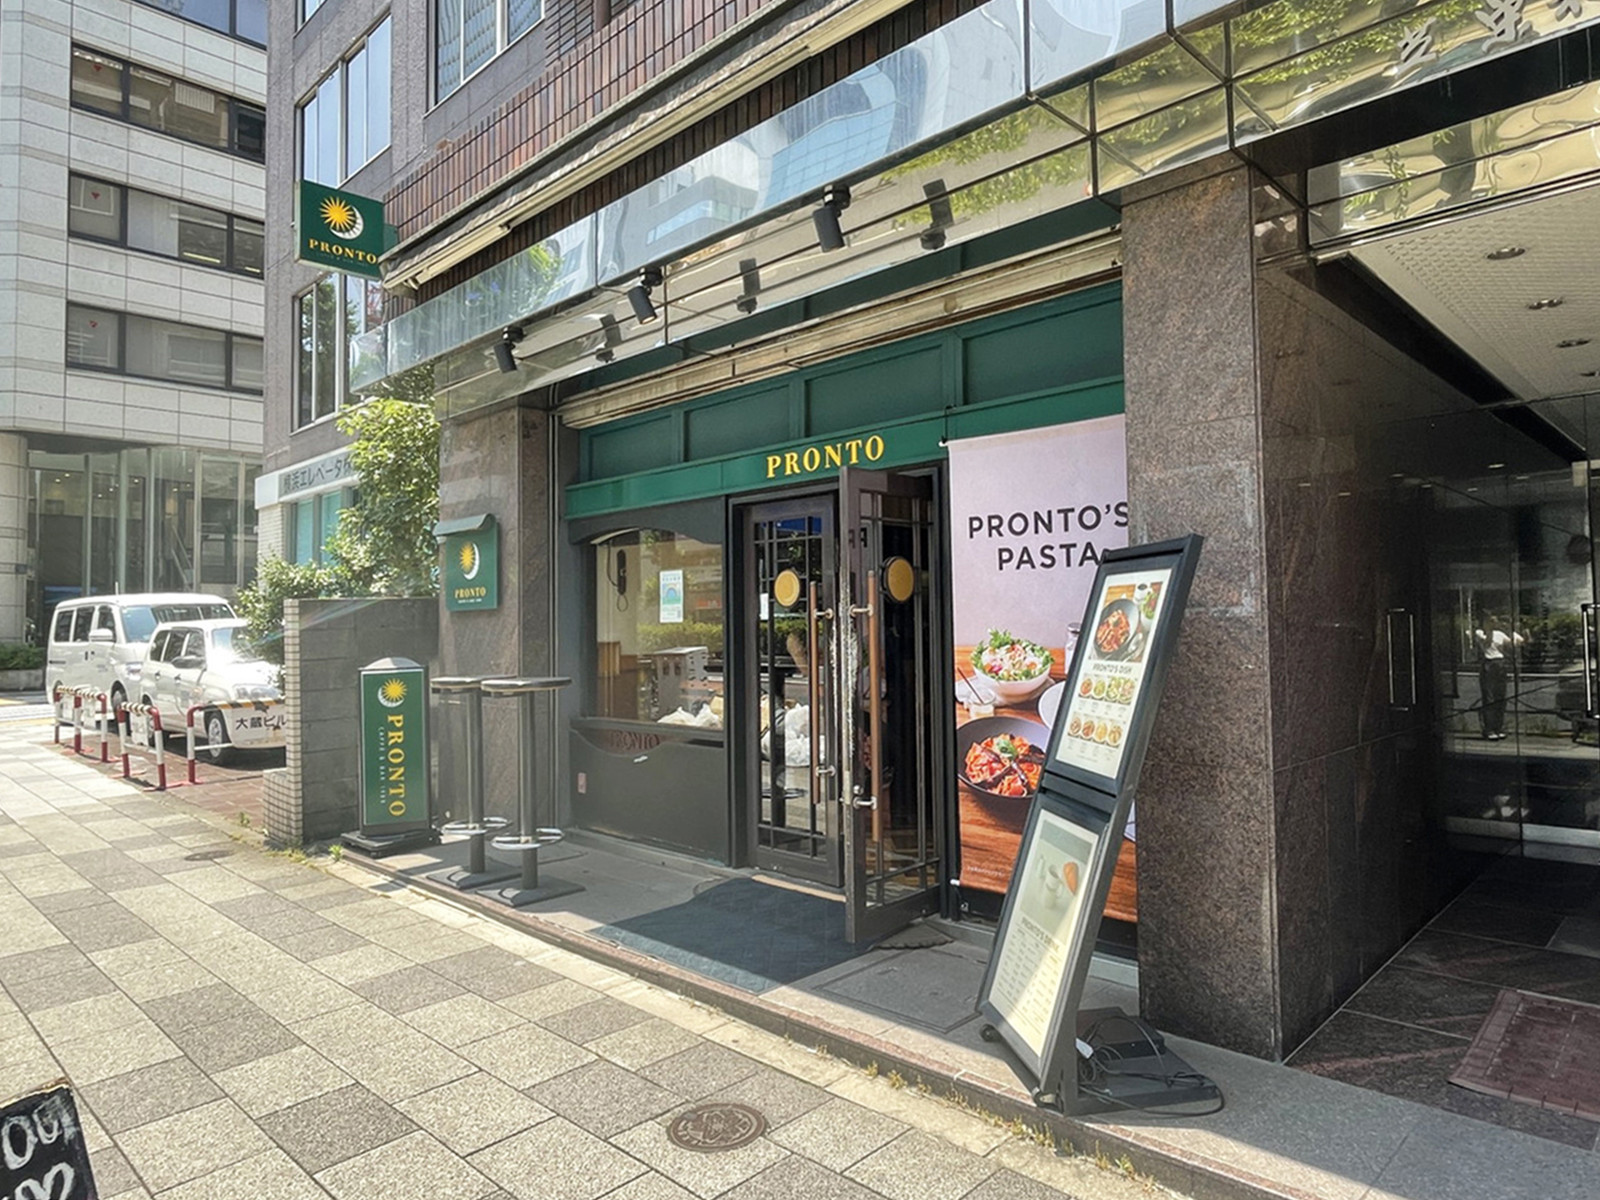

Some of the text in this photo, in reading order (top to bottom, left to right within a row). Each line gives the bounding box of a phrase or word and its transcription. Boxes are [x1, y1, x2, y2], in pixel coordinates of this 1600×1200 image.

[308, 238, 377, 264] PRONTO
[766, 434, 884, 478] PRONTO
[968, 501, 1128, 539] PRONTO'S
[997, 541, 1101, 571] PASTA
[454, 586, 487, 599] PRONTO
[235, 714, 288, 730] 大蔵ビル
[387, 714, 406, 816] PRONTO
